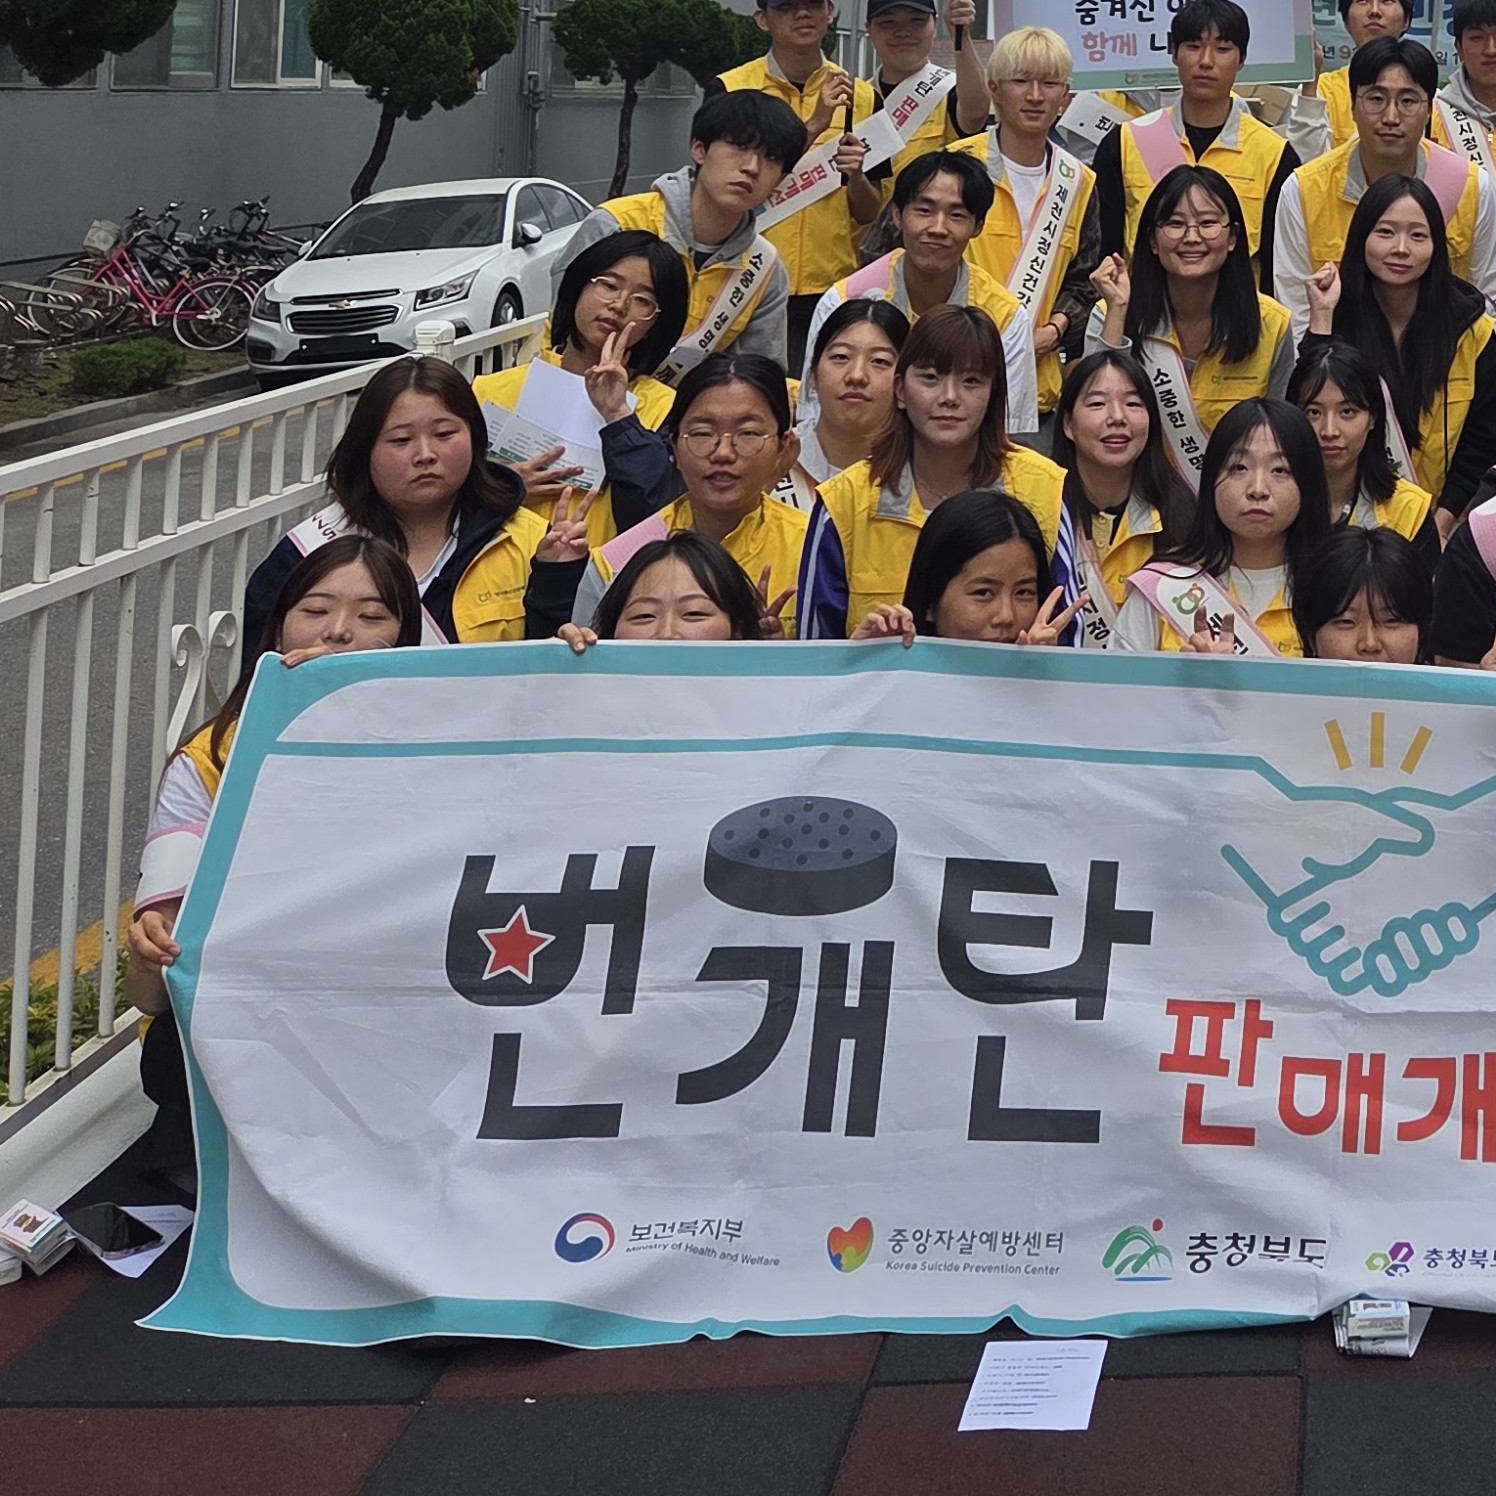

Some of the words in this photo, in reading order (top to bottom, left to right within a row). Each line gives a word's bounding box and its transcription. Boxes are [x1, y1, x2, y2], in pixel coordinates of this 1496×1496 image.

[1081, 31, 1138, 62] 함께
[729, 252, 764, 308] 소중한
[1153, 368, 1187, 429] 소중한
[445, 845, 1153, 1144] 번개탄
[628, 1218, 744, 1243] 보건복지부
[888, 1228, 1064, 1257] 중앙자살예방센터
[671, 1242, 683, 1251] of
[684, 1242, 717, 1259] Health
[718, 1251, 740, 1263] and
[741, 1254, 782, 1267] Welfare
[886, 1260, 917, 1271] Korea
[920, 1260, 961, 1273] Suicide
[962, 1262, 1022, 1275] Prevention
[1023, 1264, 1061, 1276] Center
[1186, 1231, 1328, 1274] 충청북도
